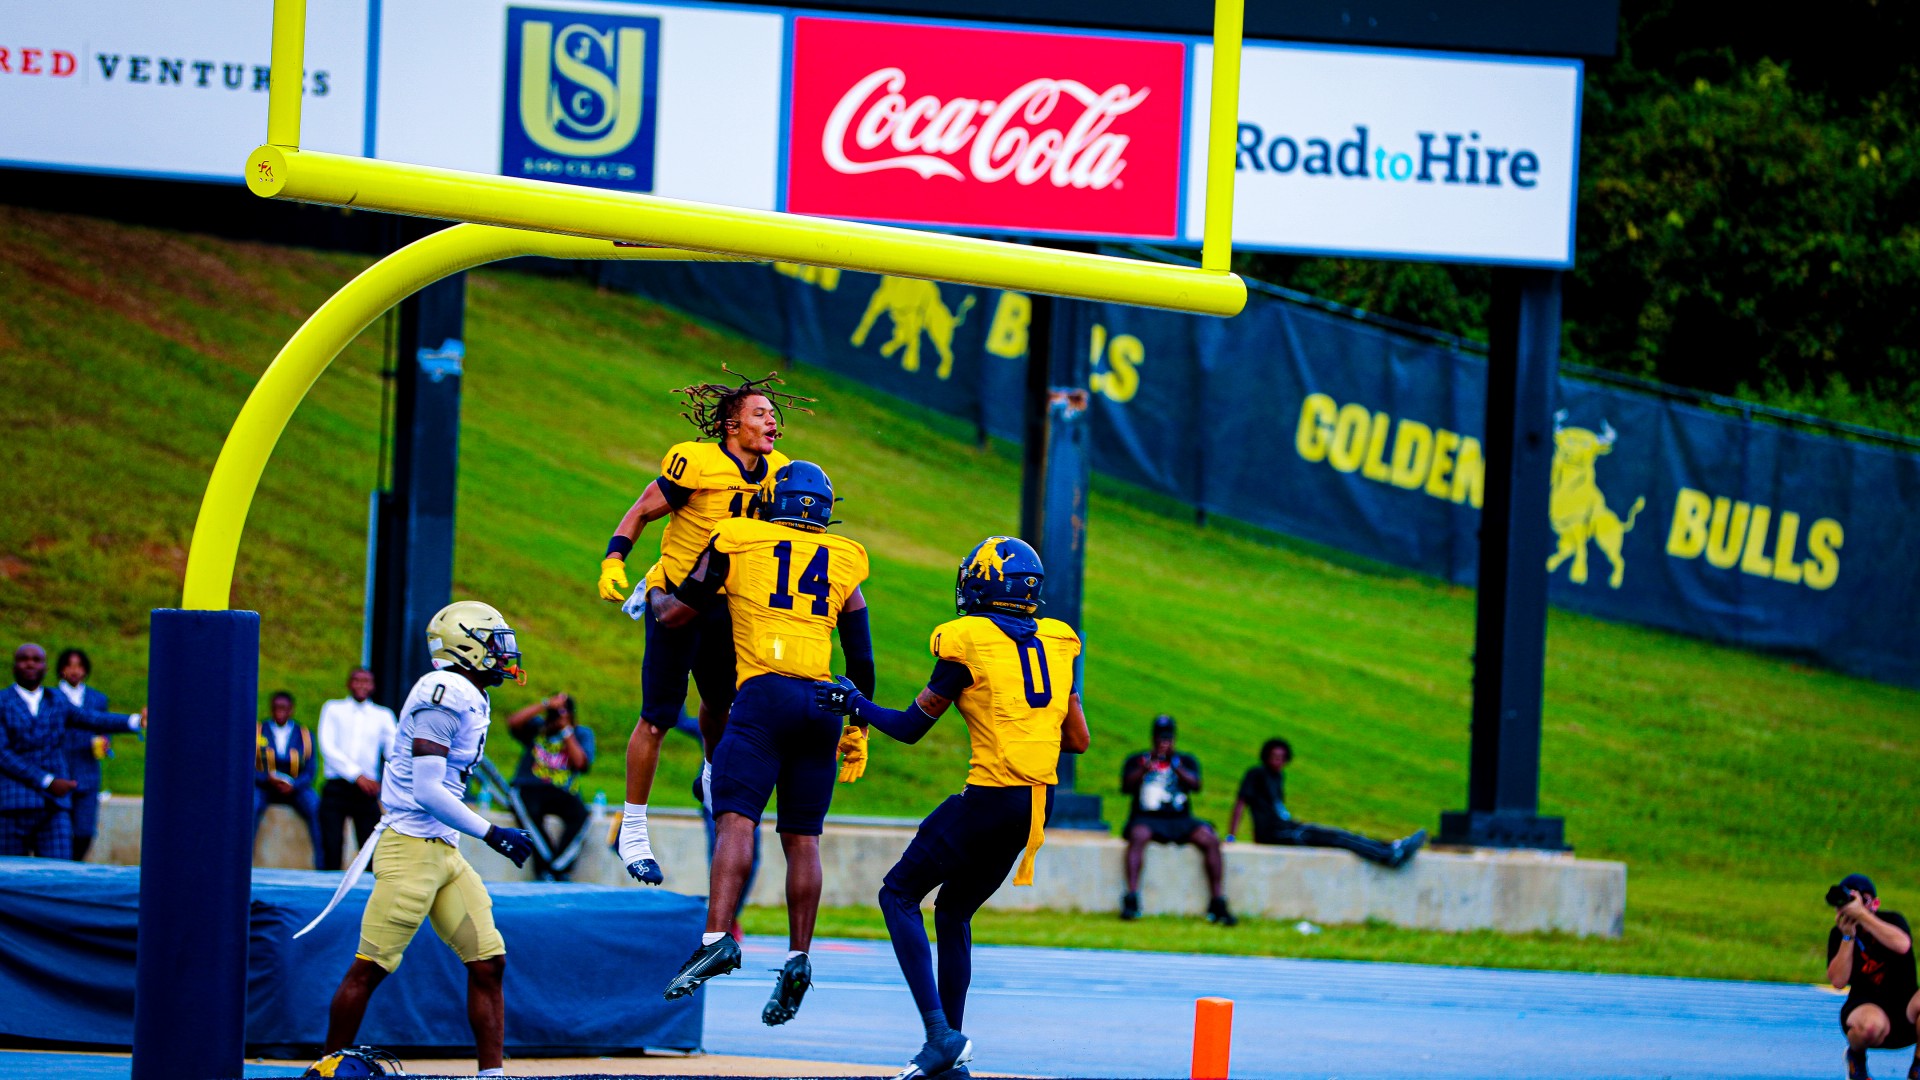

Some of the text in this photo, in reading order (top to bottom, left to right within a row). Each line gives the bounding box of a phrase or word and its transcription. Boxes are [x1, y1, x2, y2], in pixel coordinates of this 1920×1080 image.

[98, 54, 331, 96] VENTURS
[822, 67, 1151, 190] Coca-Cola
[1236, 122, 1540, 188] Road to Hire
[666, 452, 688, 480] 10
[1296, 393, 1844, 590] GOLDEN BULLS
[769, 541, 831, 617] 14
[432, 684, 446, 704] 0
[1016, 635, 1053, 708] 0
